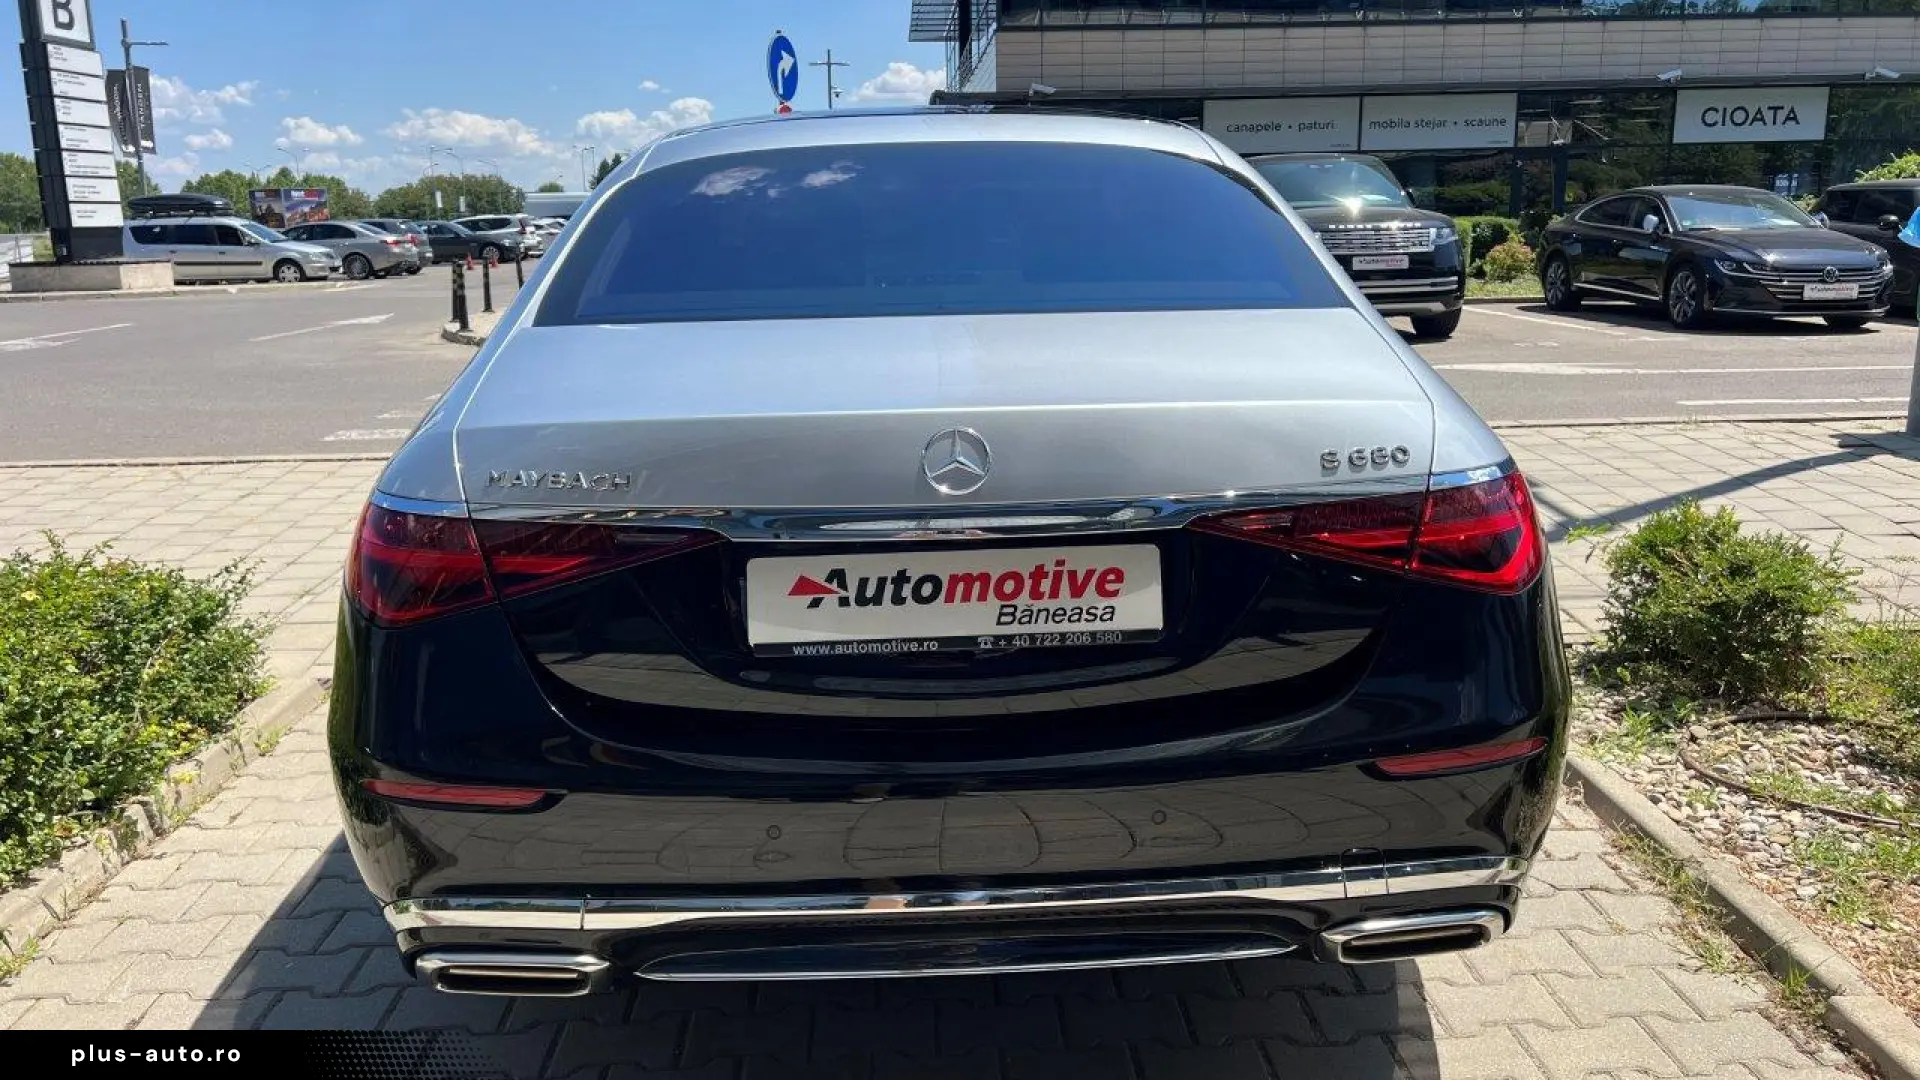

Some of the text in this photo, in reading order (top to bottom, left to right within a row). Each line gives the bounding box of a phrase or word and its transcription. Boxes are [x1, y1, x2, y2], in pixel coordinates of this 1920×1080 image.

[1226, 120, 1335, 134] canapele paturi
[1369, 116, 1507, 131] mobila stejar scaune
[1700, 106, 1801, 127] CIOATA
[1320, 445, 1410, 469] S 680
[485, 469, 631, 490] MAYBACH
[804, 558, 1125, 609] Automotive
[996, 604, 1116, 626] Băneasa
[792, 640, 939, 655] www.automotive.ro
[1012, 636, 1030, 646] 40
[1035, 634, 1061, 646] 722
[1065, 632, 1091, 644] 206
[1096, 631, 1122, 643] 580
